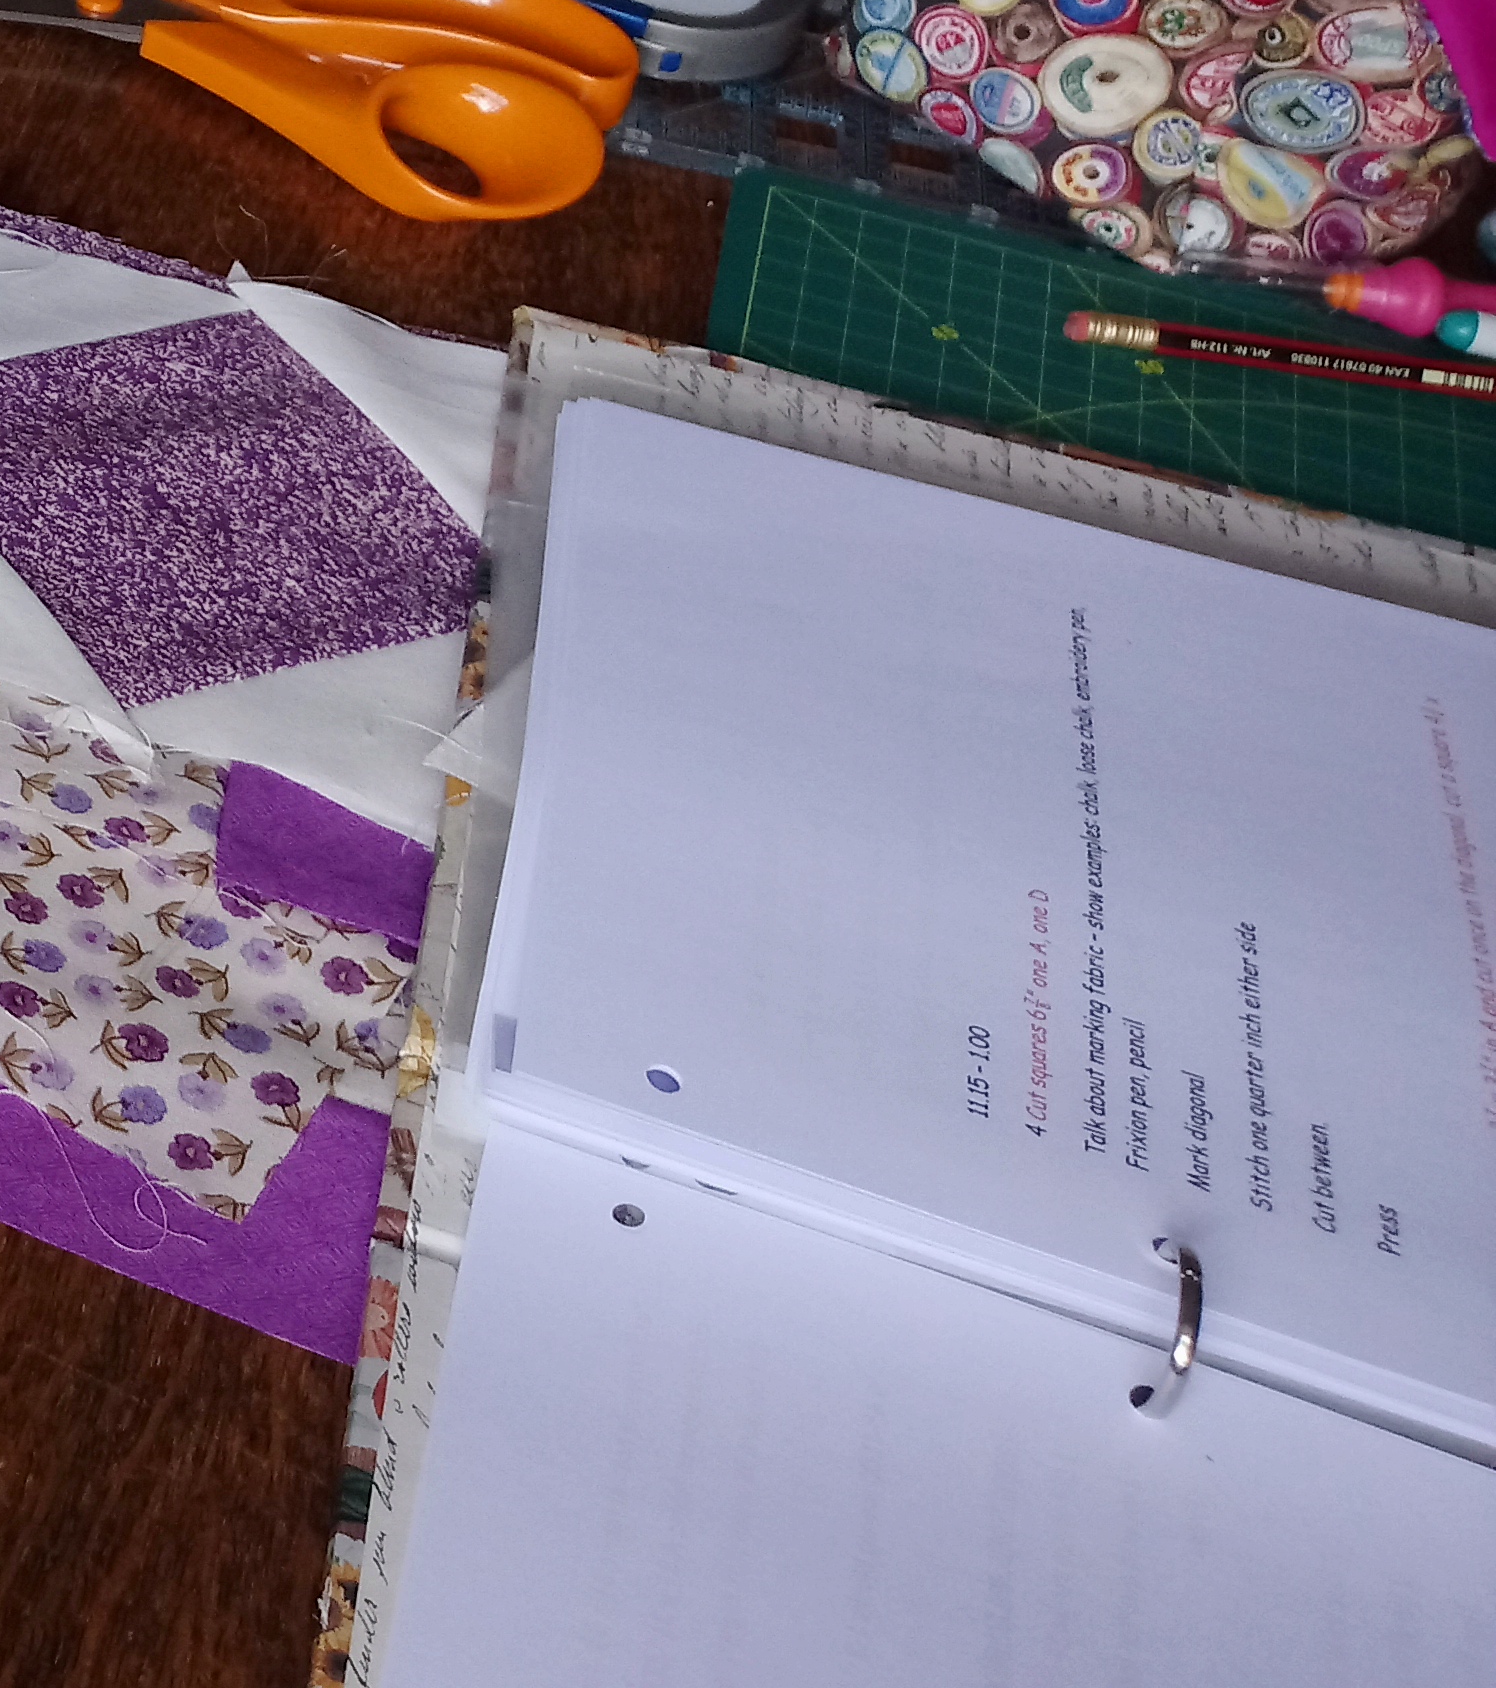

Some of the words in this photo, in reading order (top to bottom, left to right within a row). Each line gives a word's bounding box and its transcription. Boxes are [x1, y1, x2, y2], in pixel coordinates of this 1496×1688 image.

[1068, 631, 1092, 701] embroidery
[1075, 741, 1097, 775] loose
[1028, 889, 1050, 903] D
[1081, 890, 1105, 931] show
[1032, 906, 1049, 934] one
[1234, 921, 1258, 955] side
[1029, 939, 1052, 956] A,
[1032, 959, 1049, 988] one
[1081, 944, 1105, 995] fabric
[1236, 957, 1262, 1011] either
[967, 1025, 991, 1062] 1.00
[1082, 998, 1112, 1065] marking
[1121, 1016, 1153, 1071] pencil
[1238, 1012, 1263, 1049] inch
[1030, 1023, 1053, 1088] squares
[966, 1075, 991, 1119] 11.15
[1083, 1067, 1106, 1117] about
[1128, 1074, 1153, 1109] pen,
[1245, 1050, 1276, 1117] quarter
[1026, 1090, 1048, 1121] Cut
[1180, 1069, 1214, 1142] diagonal
[1025, 1122, 1047, 1137] 4
[1084, 1117, 1106, 1154] Talk
[1124, 1107, 1150, 1173] Frixion
[1250, 1122, 1270, 1158] one
[1185, 1140, 1211, 1193] Mark
[1244, 1155, 1274, 1212] Stitch
[1311, 1202, 1337, 1234] Cut
[1376, 1204, 1401, 1257] Press
